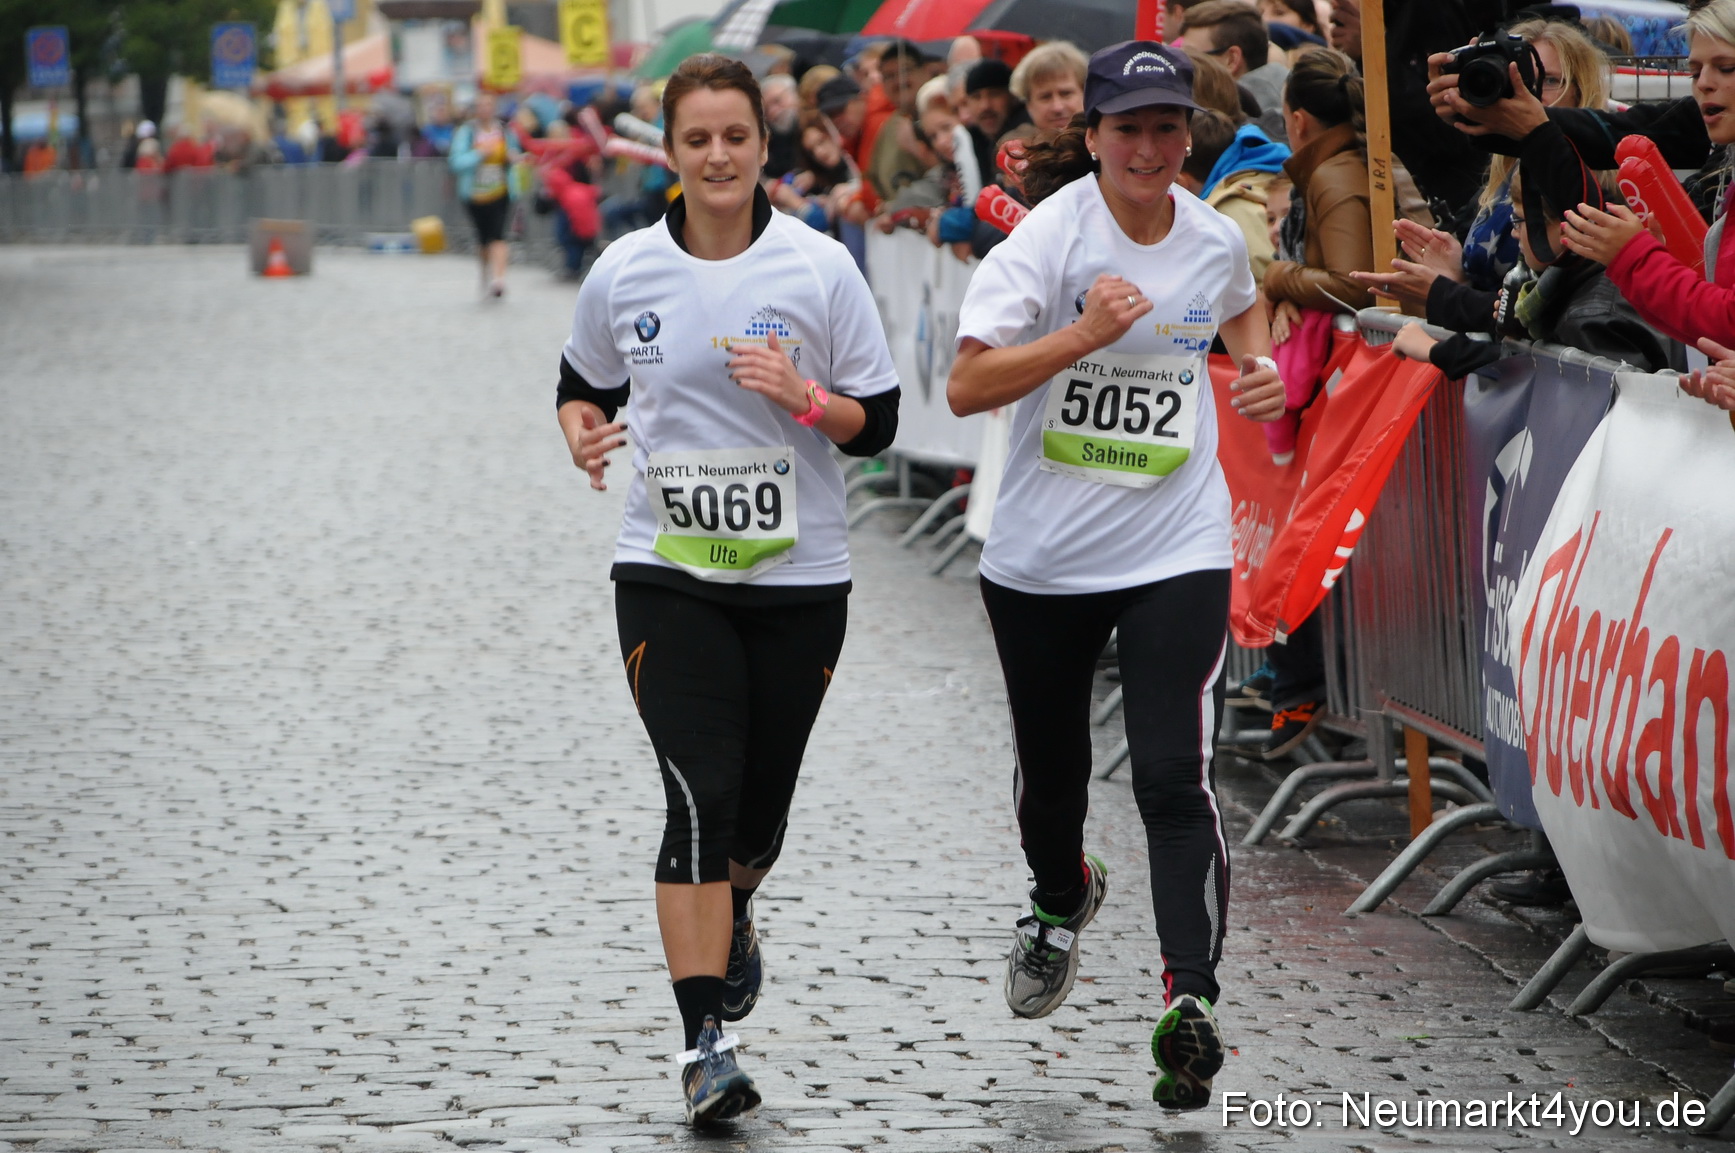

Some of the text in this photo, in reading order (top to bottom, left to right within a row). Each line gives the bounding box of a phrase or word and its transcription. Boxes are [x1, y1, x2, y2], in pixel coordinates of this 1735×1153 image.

[571, 13, 596, 48] C
[630, 345, 664, 357] PARTL
[631, 356, 664, 365] Neumarkt
[1067, 360, 1174, 382] ARTL Neumarkt
[1061, 378, 1182, 439] 5052
[1082, 442, 1148, 468] Sabine
[647, 461, 768, 478] PARTL Neumarkt
[661, 481, 782, 532] 5069
[709, 544, 738, 565] Ute
[670, 857, 677, 868] R
